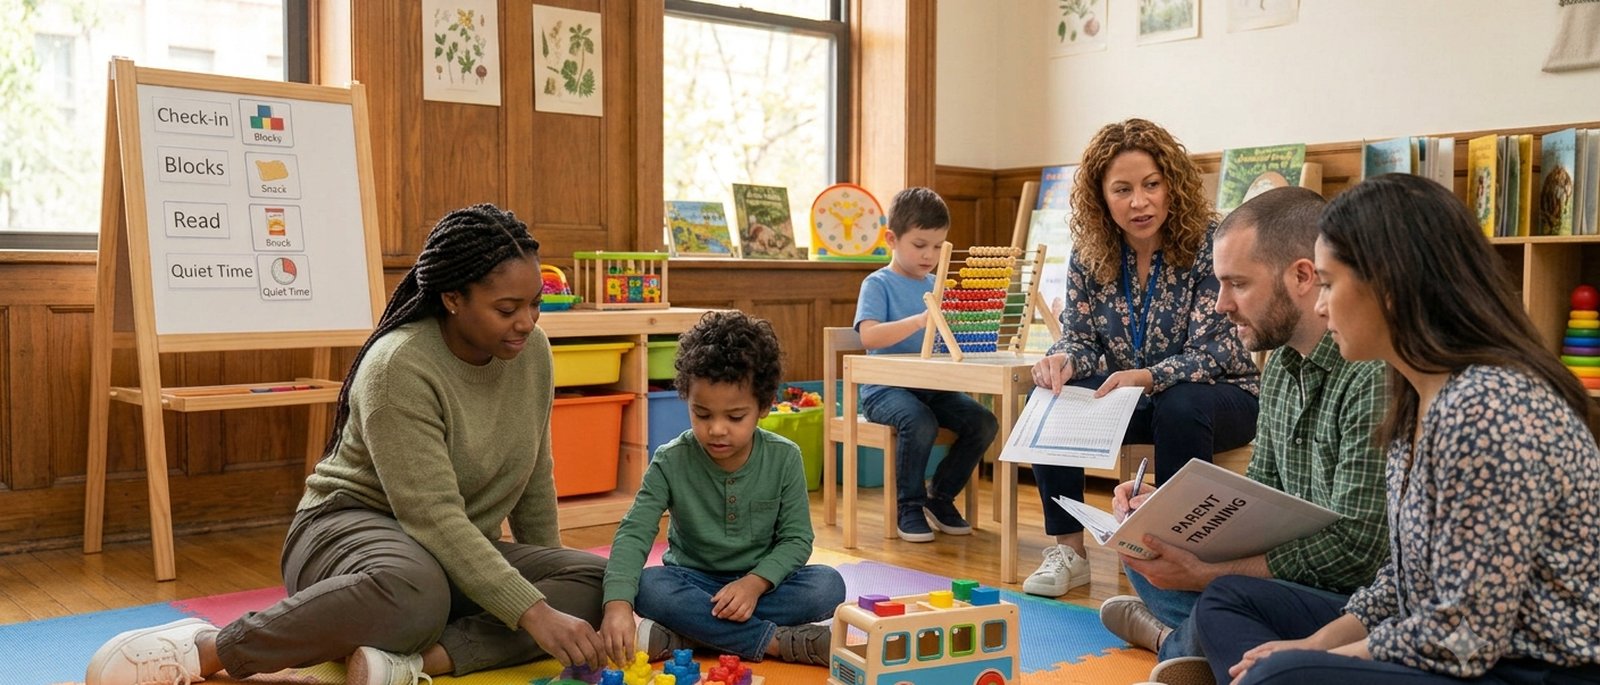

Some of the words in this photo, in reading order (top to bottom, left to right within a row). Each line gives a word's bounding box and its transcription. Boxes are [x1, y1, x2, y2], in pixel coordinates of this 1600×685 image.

[157, 107, 229, 126] Check-in
[165, 156, 225, 176] Blocks
[174, 211, 221, 229] Read
[171, 264, 213, 279] Quiet
[217, 264, 253, 278] Time
[262, 287, 287, 298] Quiet
[289, 287, 310, 297] Time
[1171, 494, 1220, 534] PARENT
[1186, 497, 1247, 544] TRAINING
